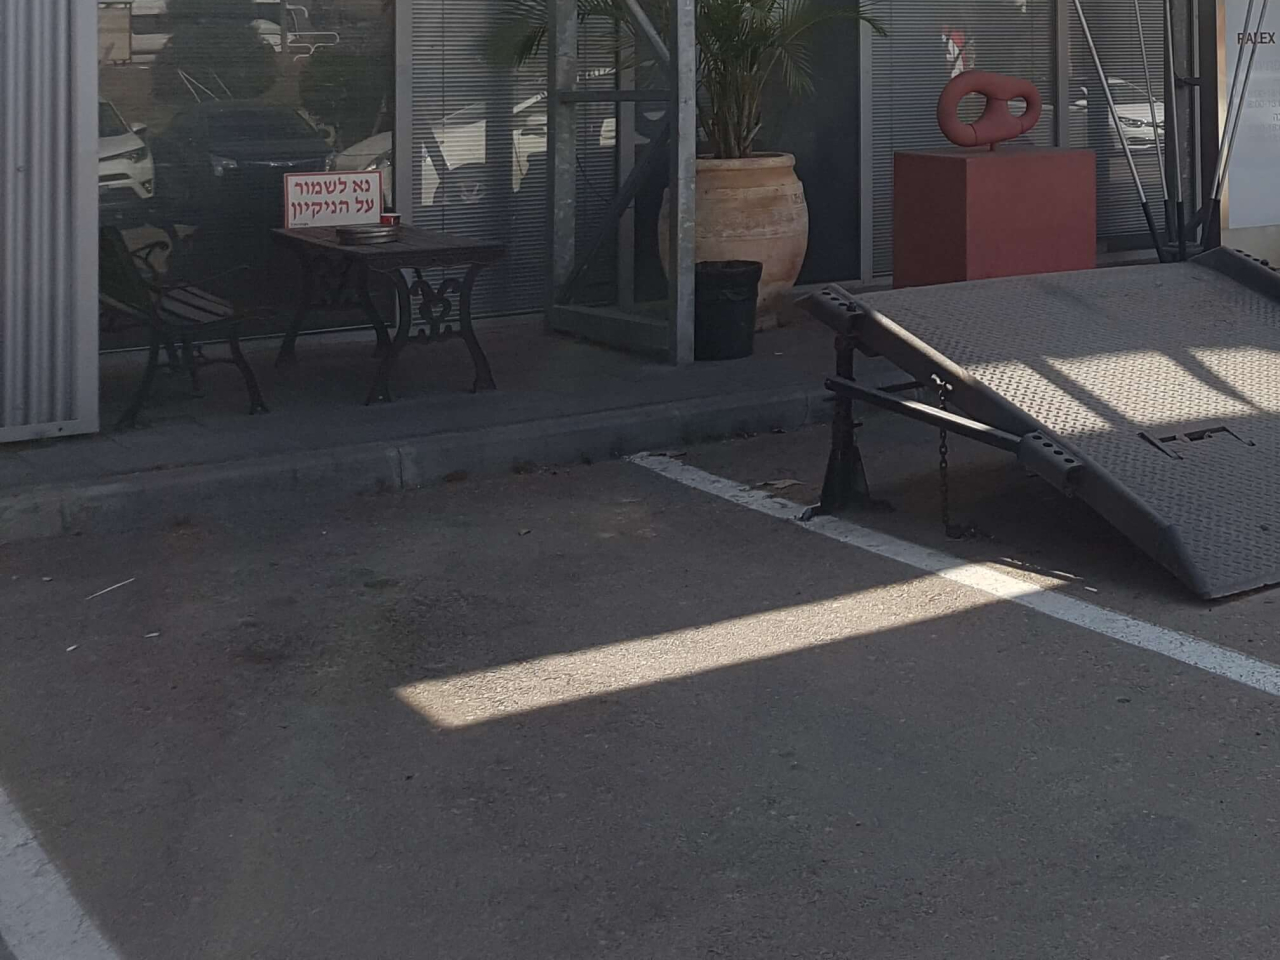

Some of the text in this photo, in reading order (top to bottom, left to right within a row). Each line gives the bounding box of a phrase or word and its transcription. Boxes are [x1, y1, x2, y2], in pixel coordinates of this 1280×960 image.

[294, 176, 371, 196] נא לשמור
[291, 196, 375, 220] על הניקיון
